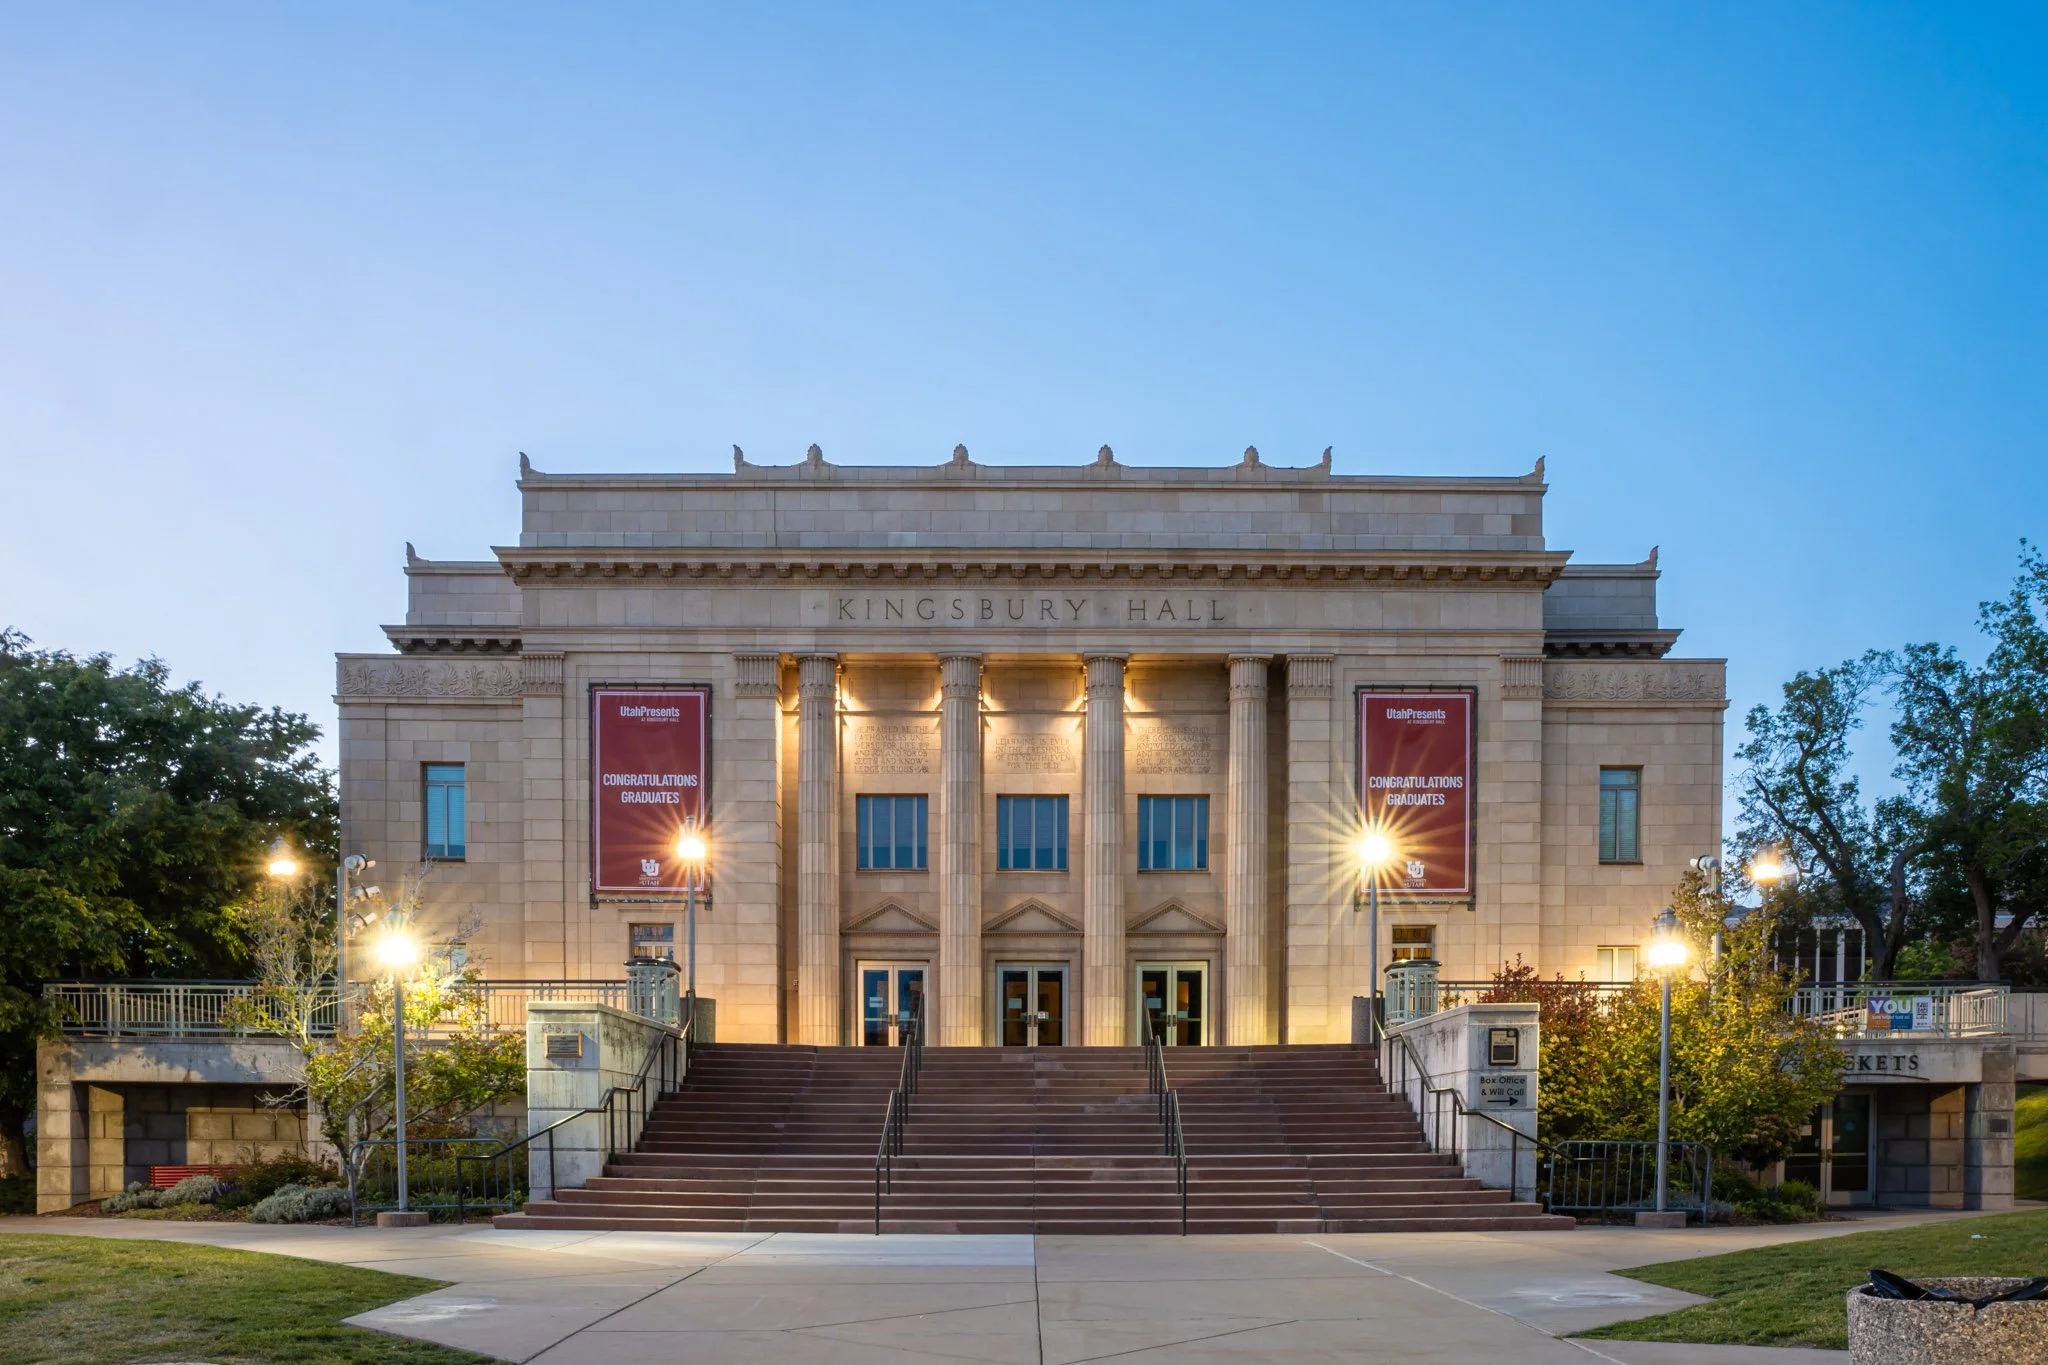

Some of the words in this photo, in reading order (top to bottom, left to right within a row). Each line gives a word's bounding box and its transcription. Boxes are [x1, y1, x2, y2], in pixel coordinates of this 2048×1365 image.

[837, 599, 1086, 620] KINGSBURY
[1127, 599, 1225, 621] HALL
[620, 706, 680, 717] UtahPresents
[1386, 708, 1446, 719] UtahPresents
[603, 774, 698, 787] CONGRATULATIONS
[1369, 776, 1463, 788] CONGRATULATIONS
[621, 791, 679, 803] GRADUATES
[1387, 793, 1445, 805] GRADUATES
[1870, 1000, 1911, 1014] YOU
[1480, 1076, 1496, 1084] Box
[1499, 1076, 1526, 1084] Office
[1481, 1088, 1487, 1096] &
[1489, 1088, 1505, 1096] Will
[1506, 1088, 1525, 1096] Call
